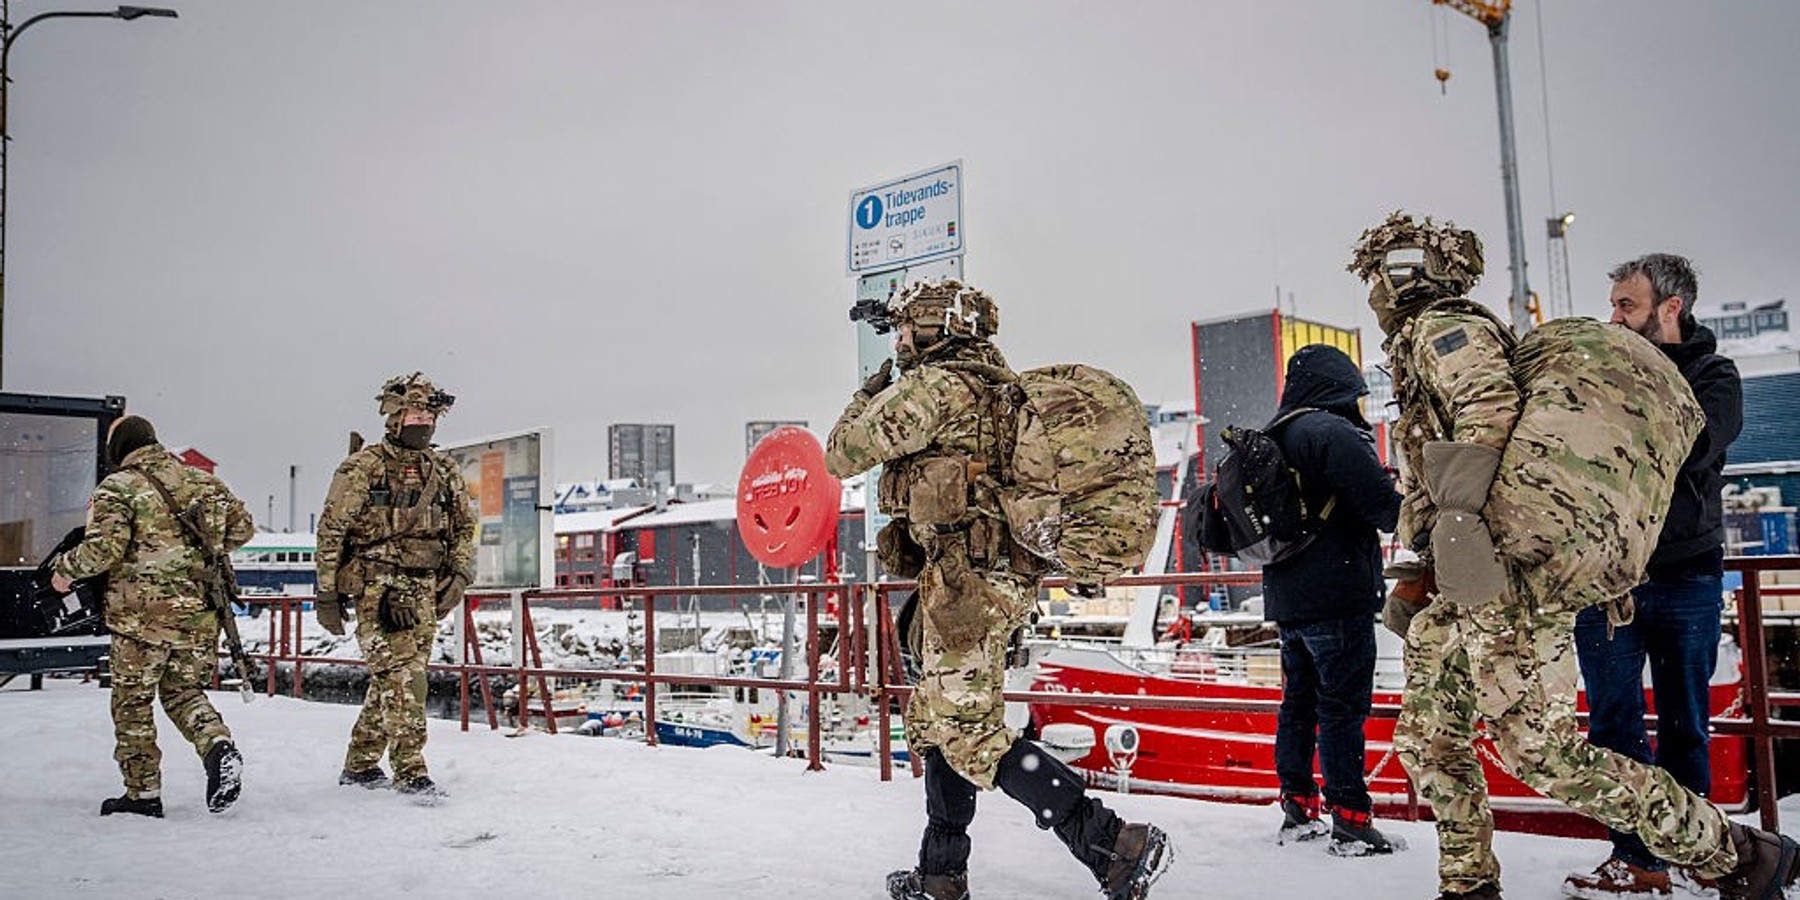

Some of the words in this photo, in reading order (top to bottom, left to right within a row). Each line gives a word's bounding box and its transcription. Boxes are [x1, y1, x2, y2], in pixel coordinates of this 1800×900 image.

[885, 179, 954, 209] Tidevands-
[864, 200, 874, 224] 1
[885, 205, 926, 228] trappe
